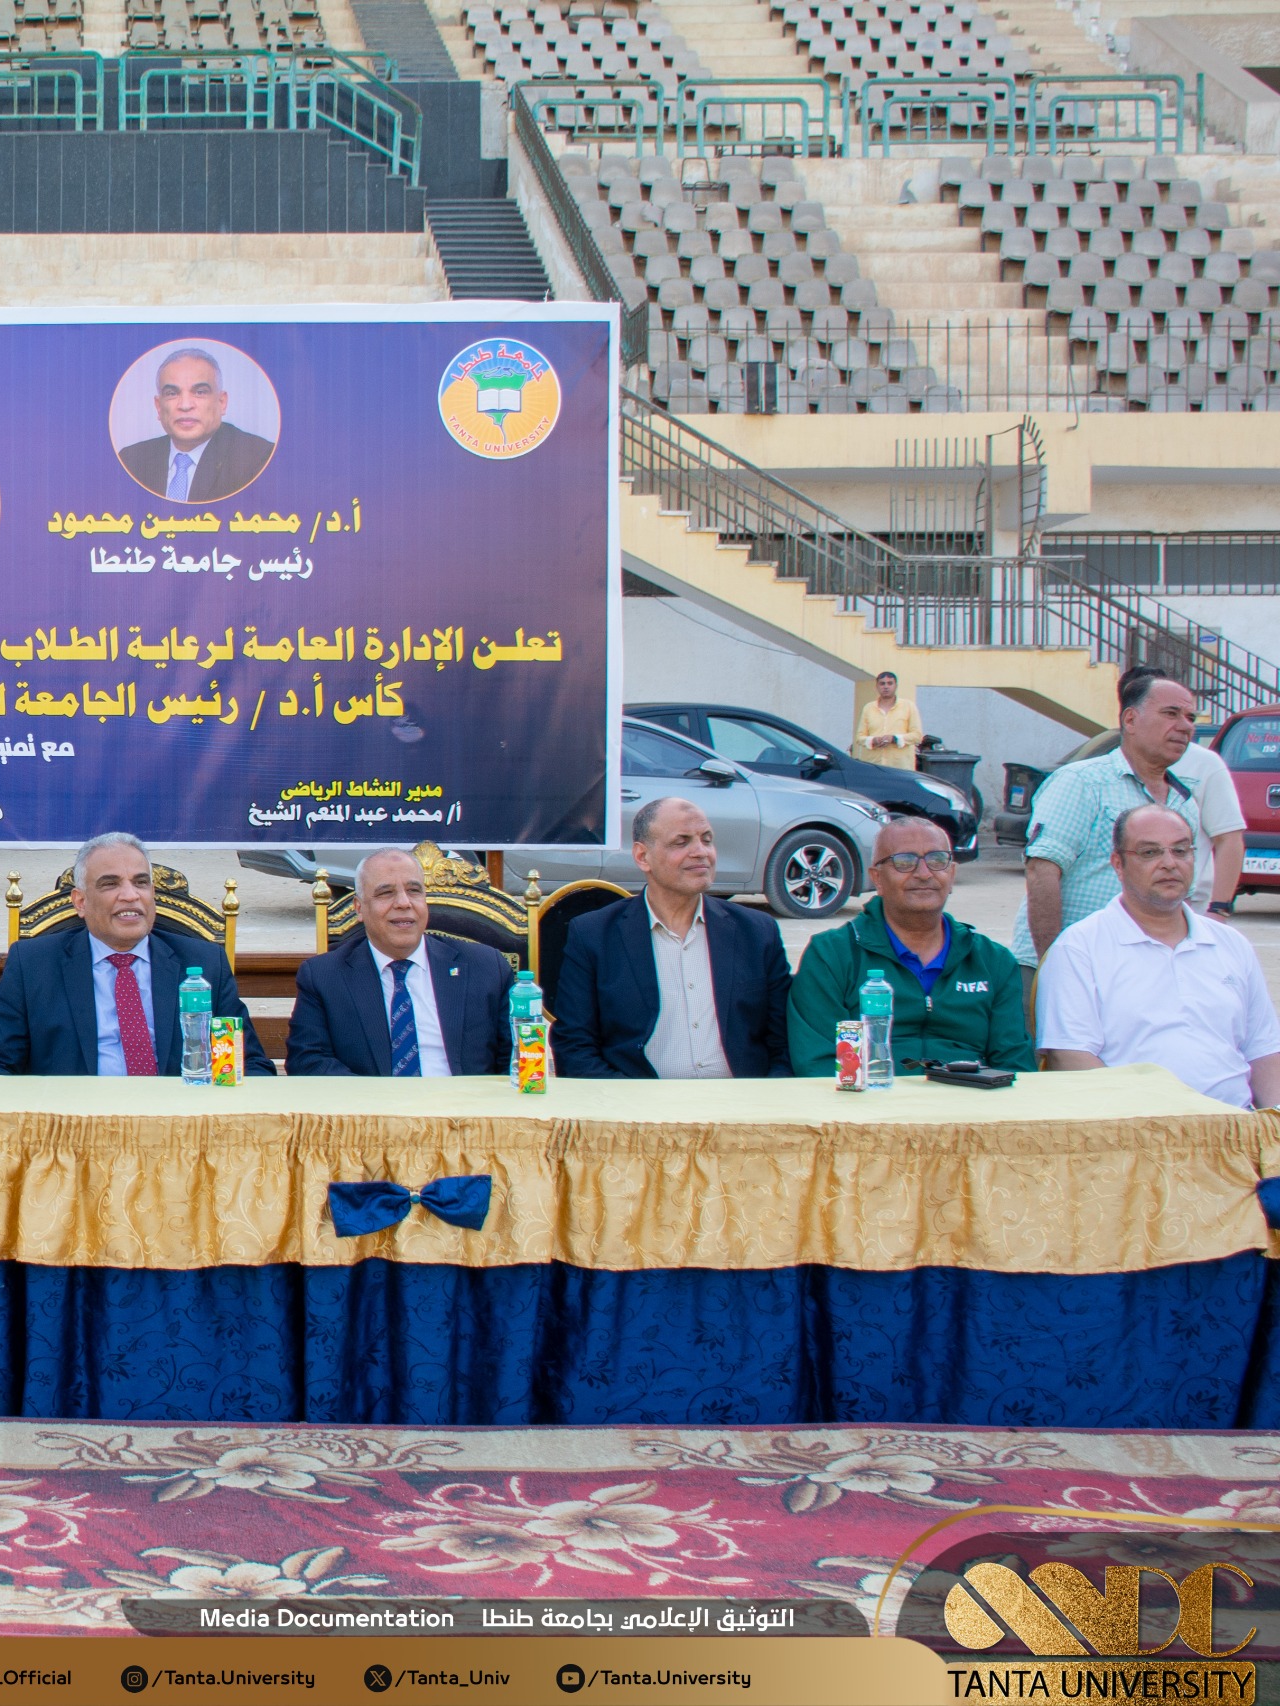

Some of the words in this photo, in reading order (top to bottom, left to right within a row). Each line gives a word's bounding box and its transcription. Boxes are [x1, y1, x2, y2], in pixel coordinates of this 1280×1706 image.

[451, 348, 492, 381] طنطا
[498, 344, 543, 381] جامعة
[449, 416, 478, 446] TANTA
[484, 417, 549, 452] UNIVERSITY
[48, 511, 134, 540] محمود
[140, 512, 221, 539] حسين
[229, 511, 301, 534] محمد
[90, 546, 156, 573] طنطا
[161, 545, 241, 581] جامعة
[248, 547, 313, 581] رئيس
[0, 627, 118, 670] الطلاب
[127, 626, 234, 670] لرعاية
[242, 626, 354, 662] العامة
[364, 626, 463, 672] الإدارة
[472, 628, 563, 670] تعلن
[14, 680, 137, 724] الجامعة
[147, 679, 239, 725] رئيس
[333, 672, 405, 725] كأس
[40, 738, 75, 761] مع
[281, 780, 342, 801] الرياضى
[346, 778, 401, 797] النشاط
[404, 782, 442, 802] مدير
[248, 801, 301, 826] الشيخ
[306, 804, 350, 829] المنعم
[354, 807, 388, 826] عبد
[392, 807, 442, 823] محمد
[955, 980, 988, 992] FIFA
[520, 1051, 542, 1059] Mango
